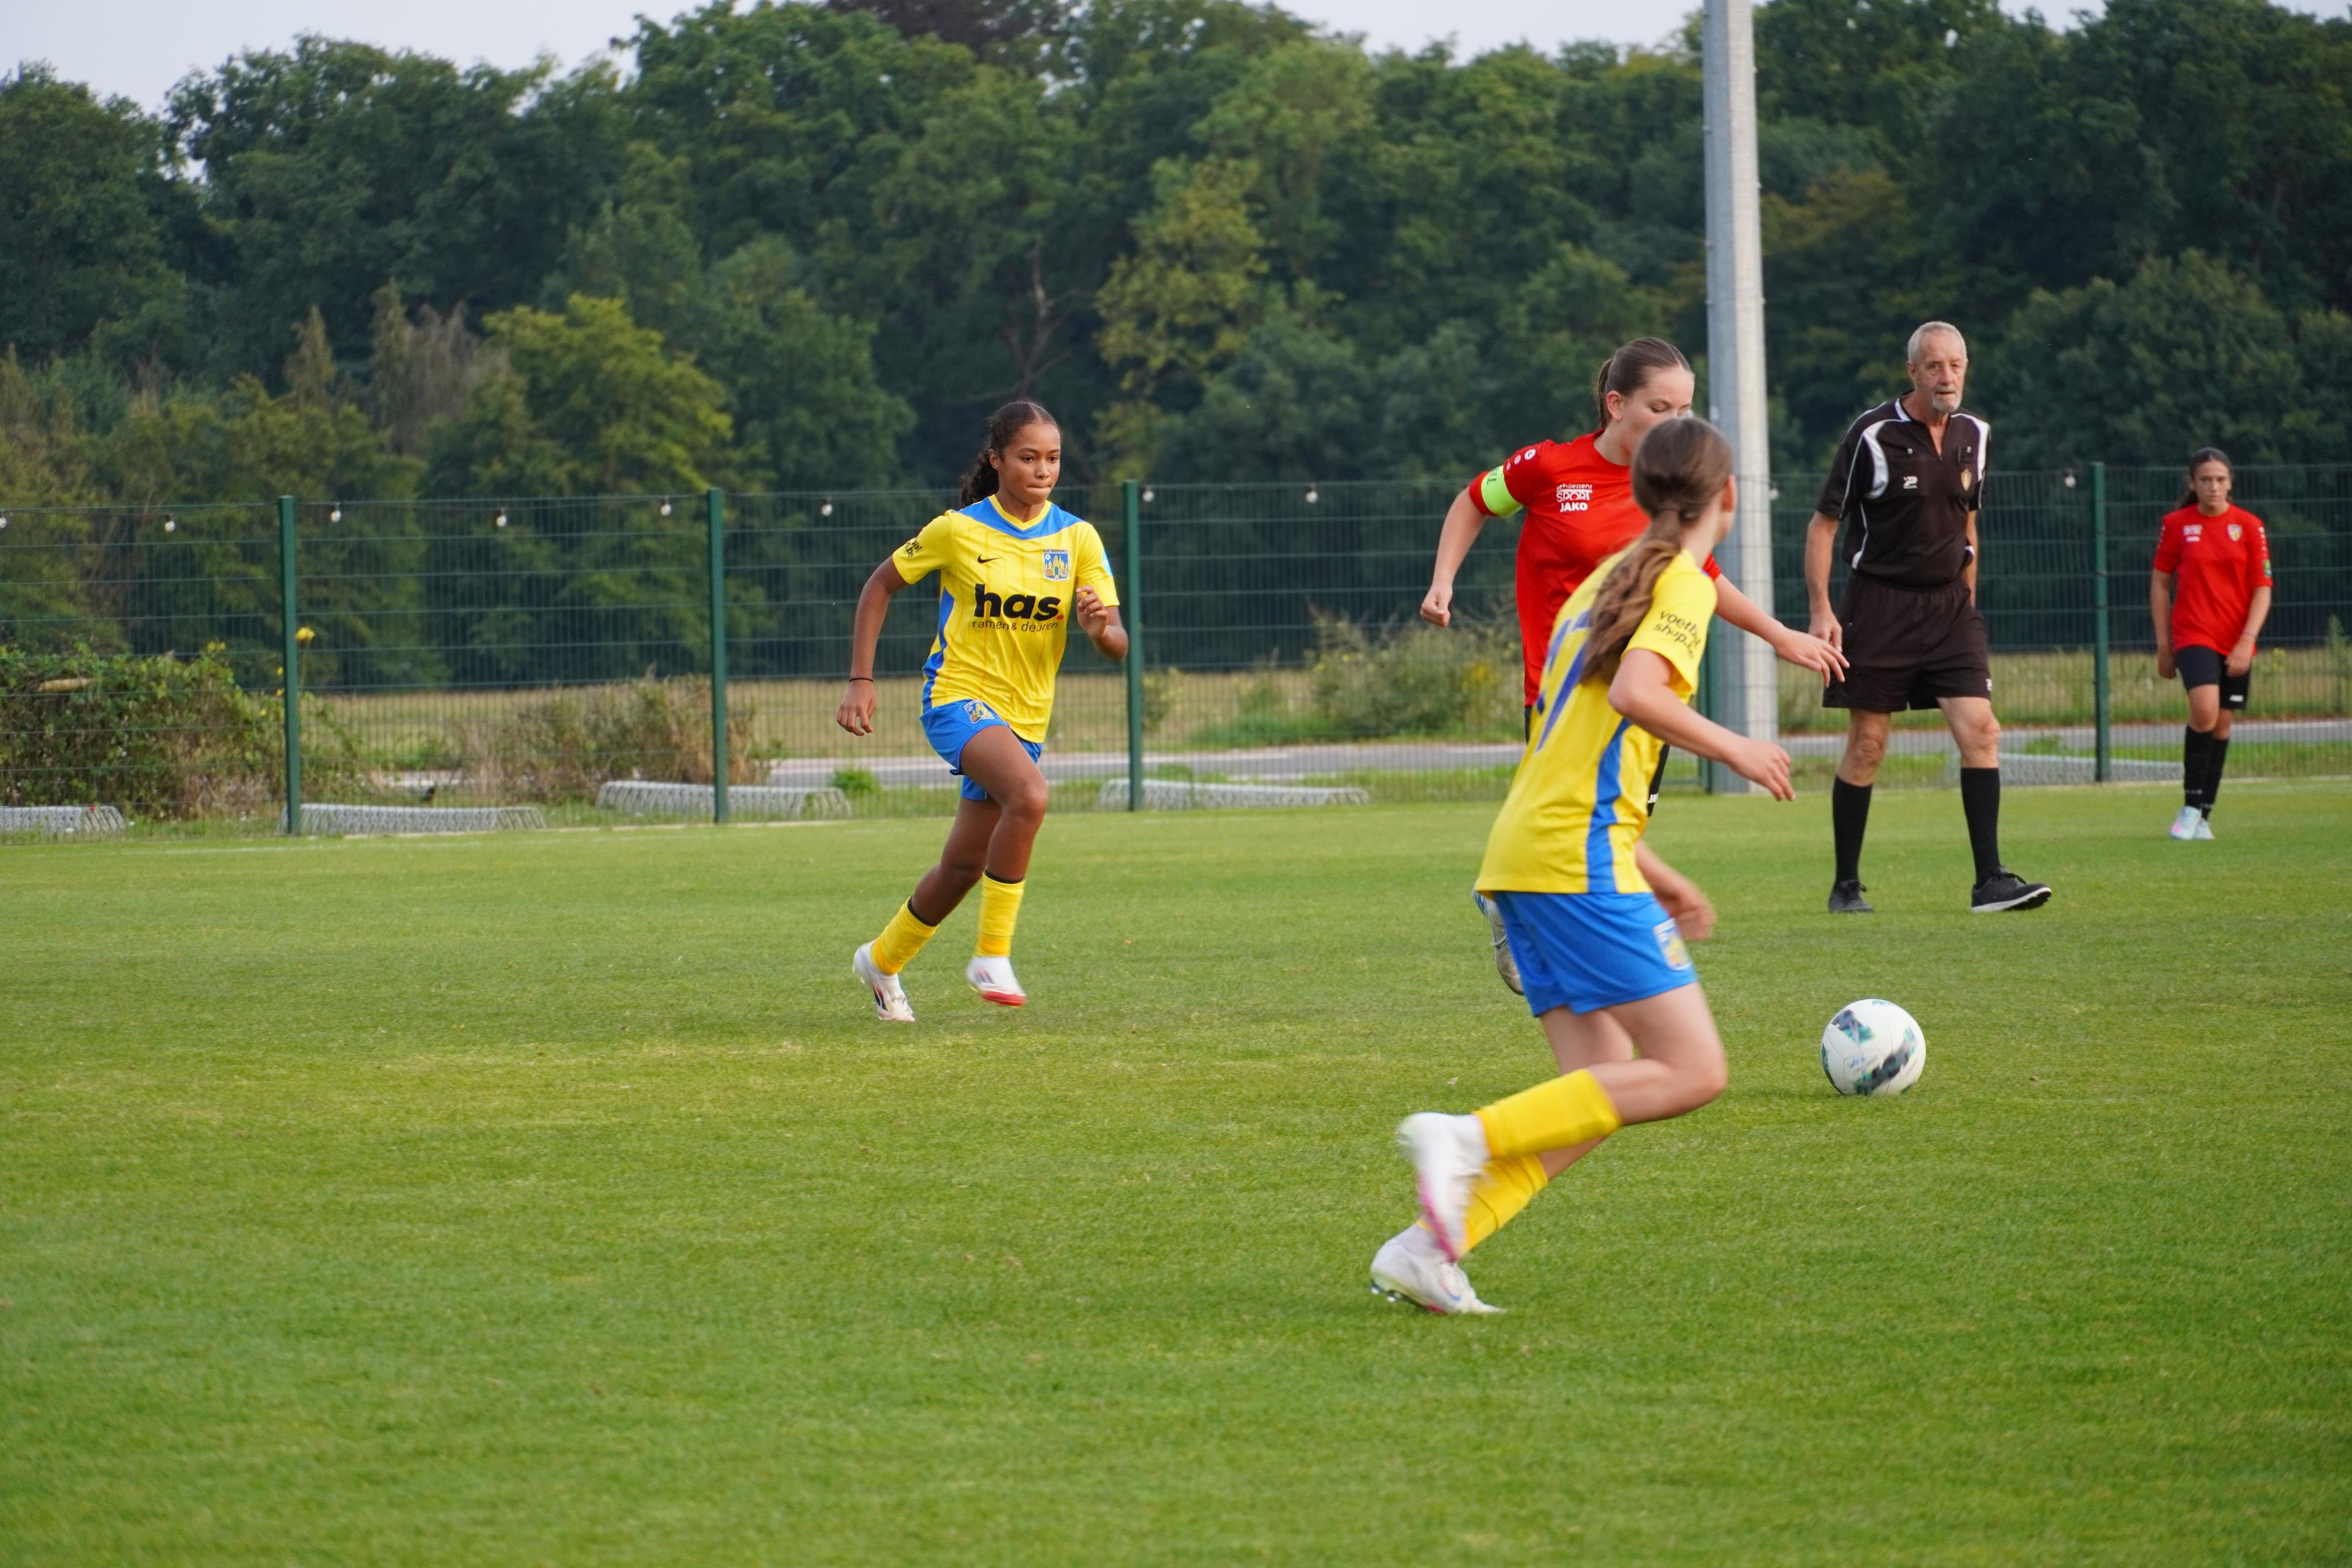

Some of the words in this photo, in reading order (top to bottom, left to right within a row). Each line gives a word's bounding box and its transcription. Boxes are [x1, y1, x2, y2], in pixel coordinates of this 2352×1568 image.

[1556, 489, 1593, 502] SPORT
[1559, 502, 1588, 513] JAKO
[973, 620, 1009, 631] ramen
[1011, 622, 1017, 631] &
[1021, 621, 1059, 633] deuren
